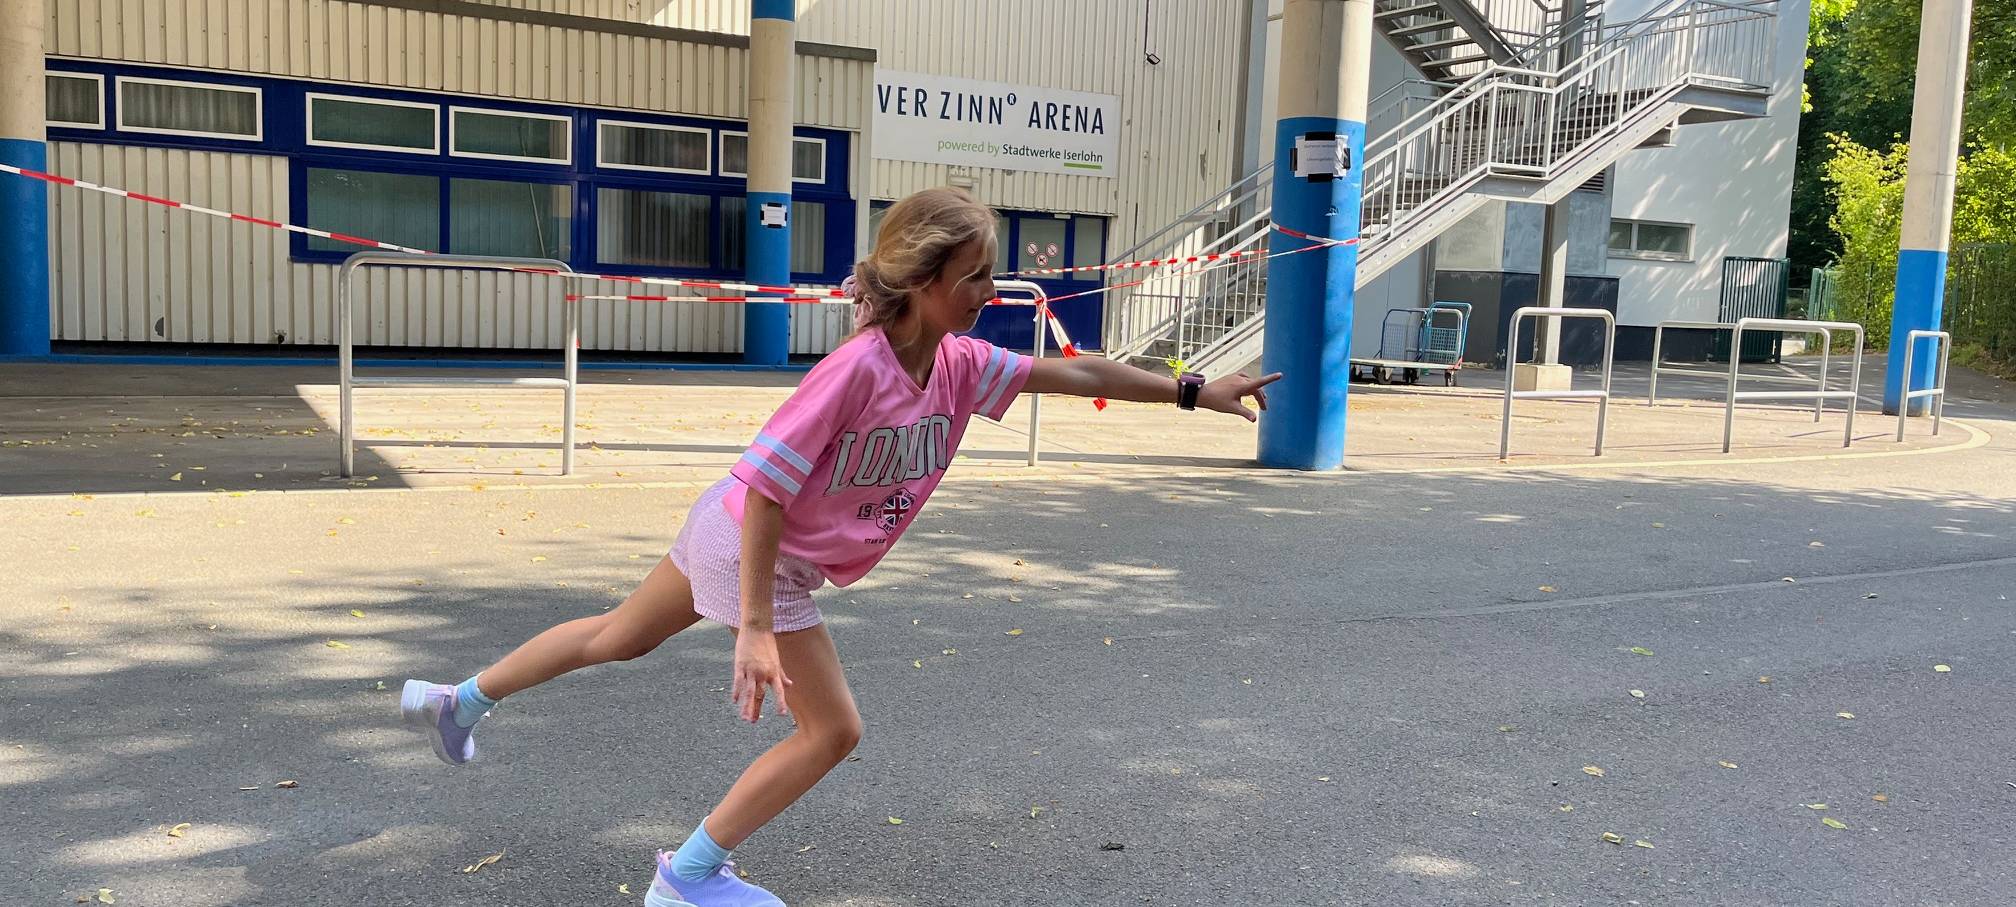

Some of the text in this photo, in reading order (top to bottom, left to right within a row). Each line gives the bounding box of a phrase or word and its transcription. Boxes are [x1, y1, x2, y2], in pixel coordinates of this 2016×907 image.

[877, 84, 928, 118] VER
[1028, 101, 1105, 135] ARENA
[937, 139, 1104, 164] powered by Stadtwerke Iserlohn
